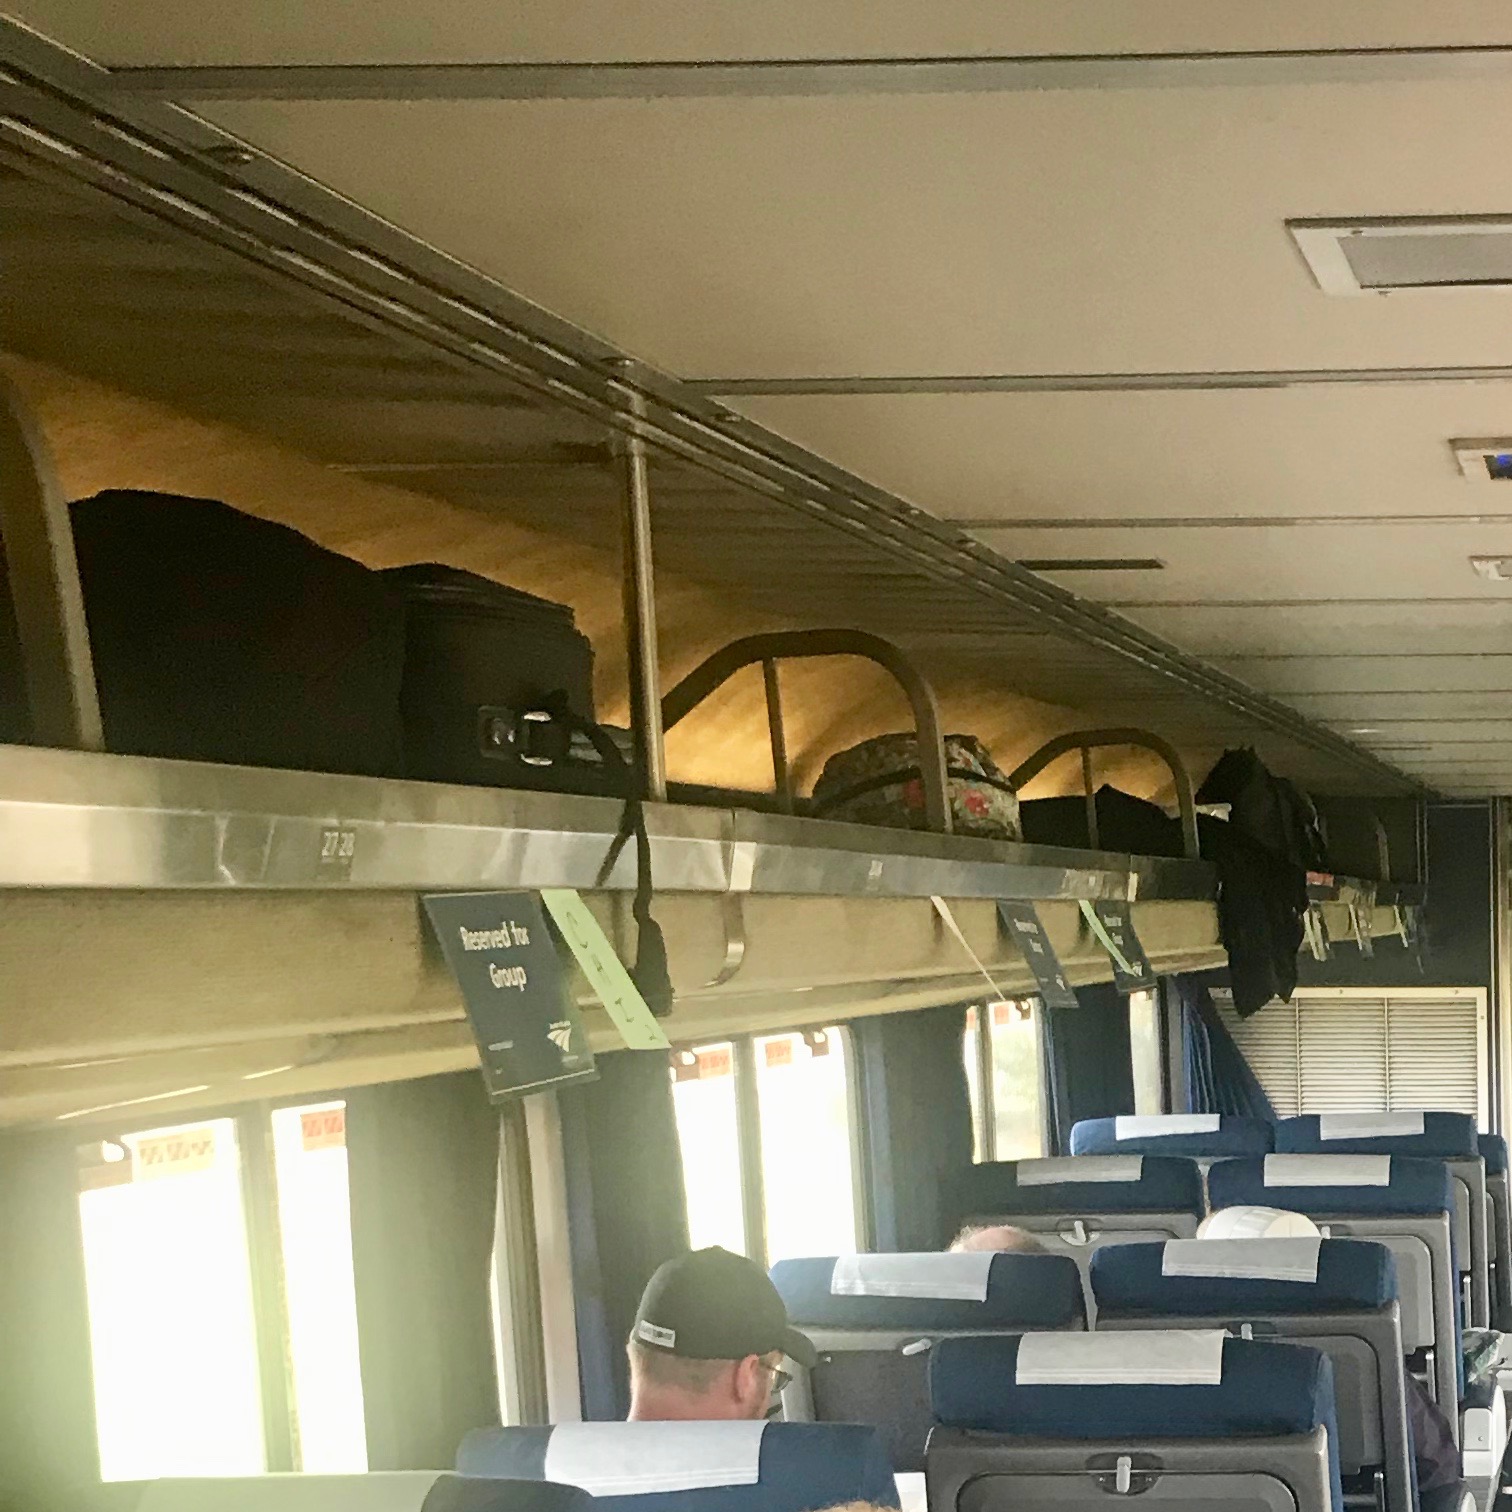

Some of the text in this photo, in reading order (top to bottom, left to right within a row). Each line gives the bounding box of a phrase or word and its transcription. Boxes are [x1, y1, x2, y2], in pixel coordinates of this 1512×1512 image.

[460, 920, 530, 951] Reserved for
[490, 962, 528, 992] Group
